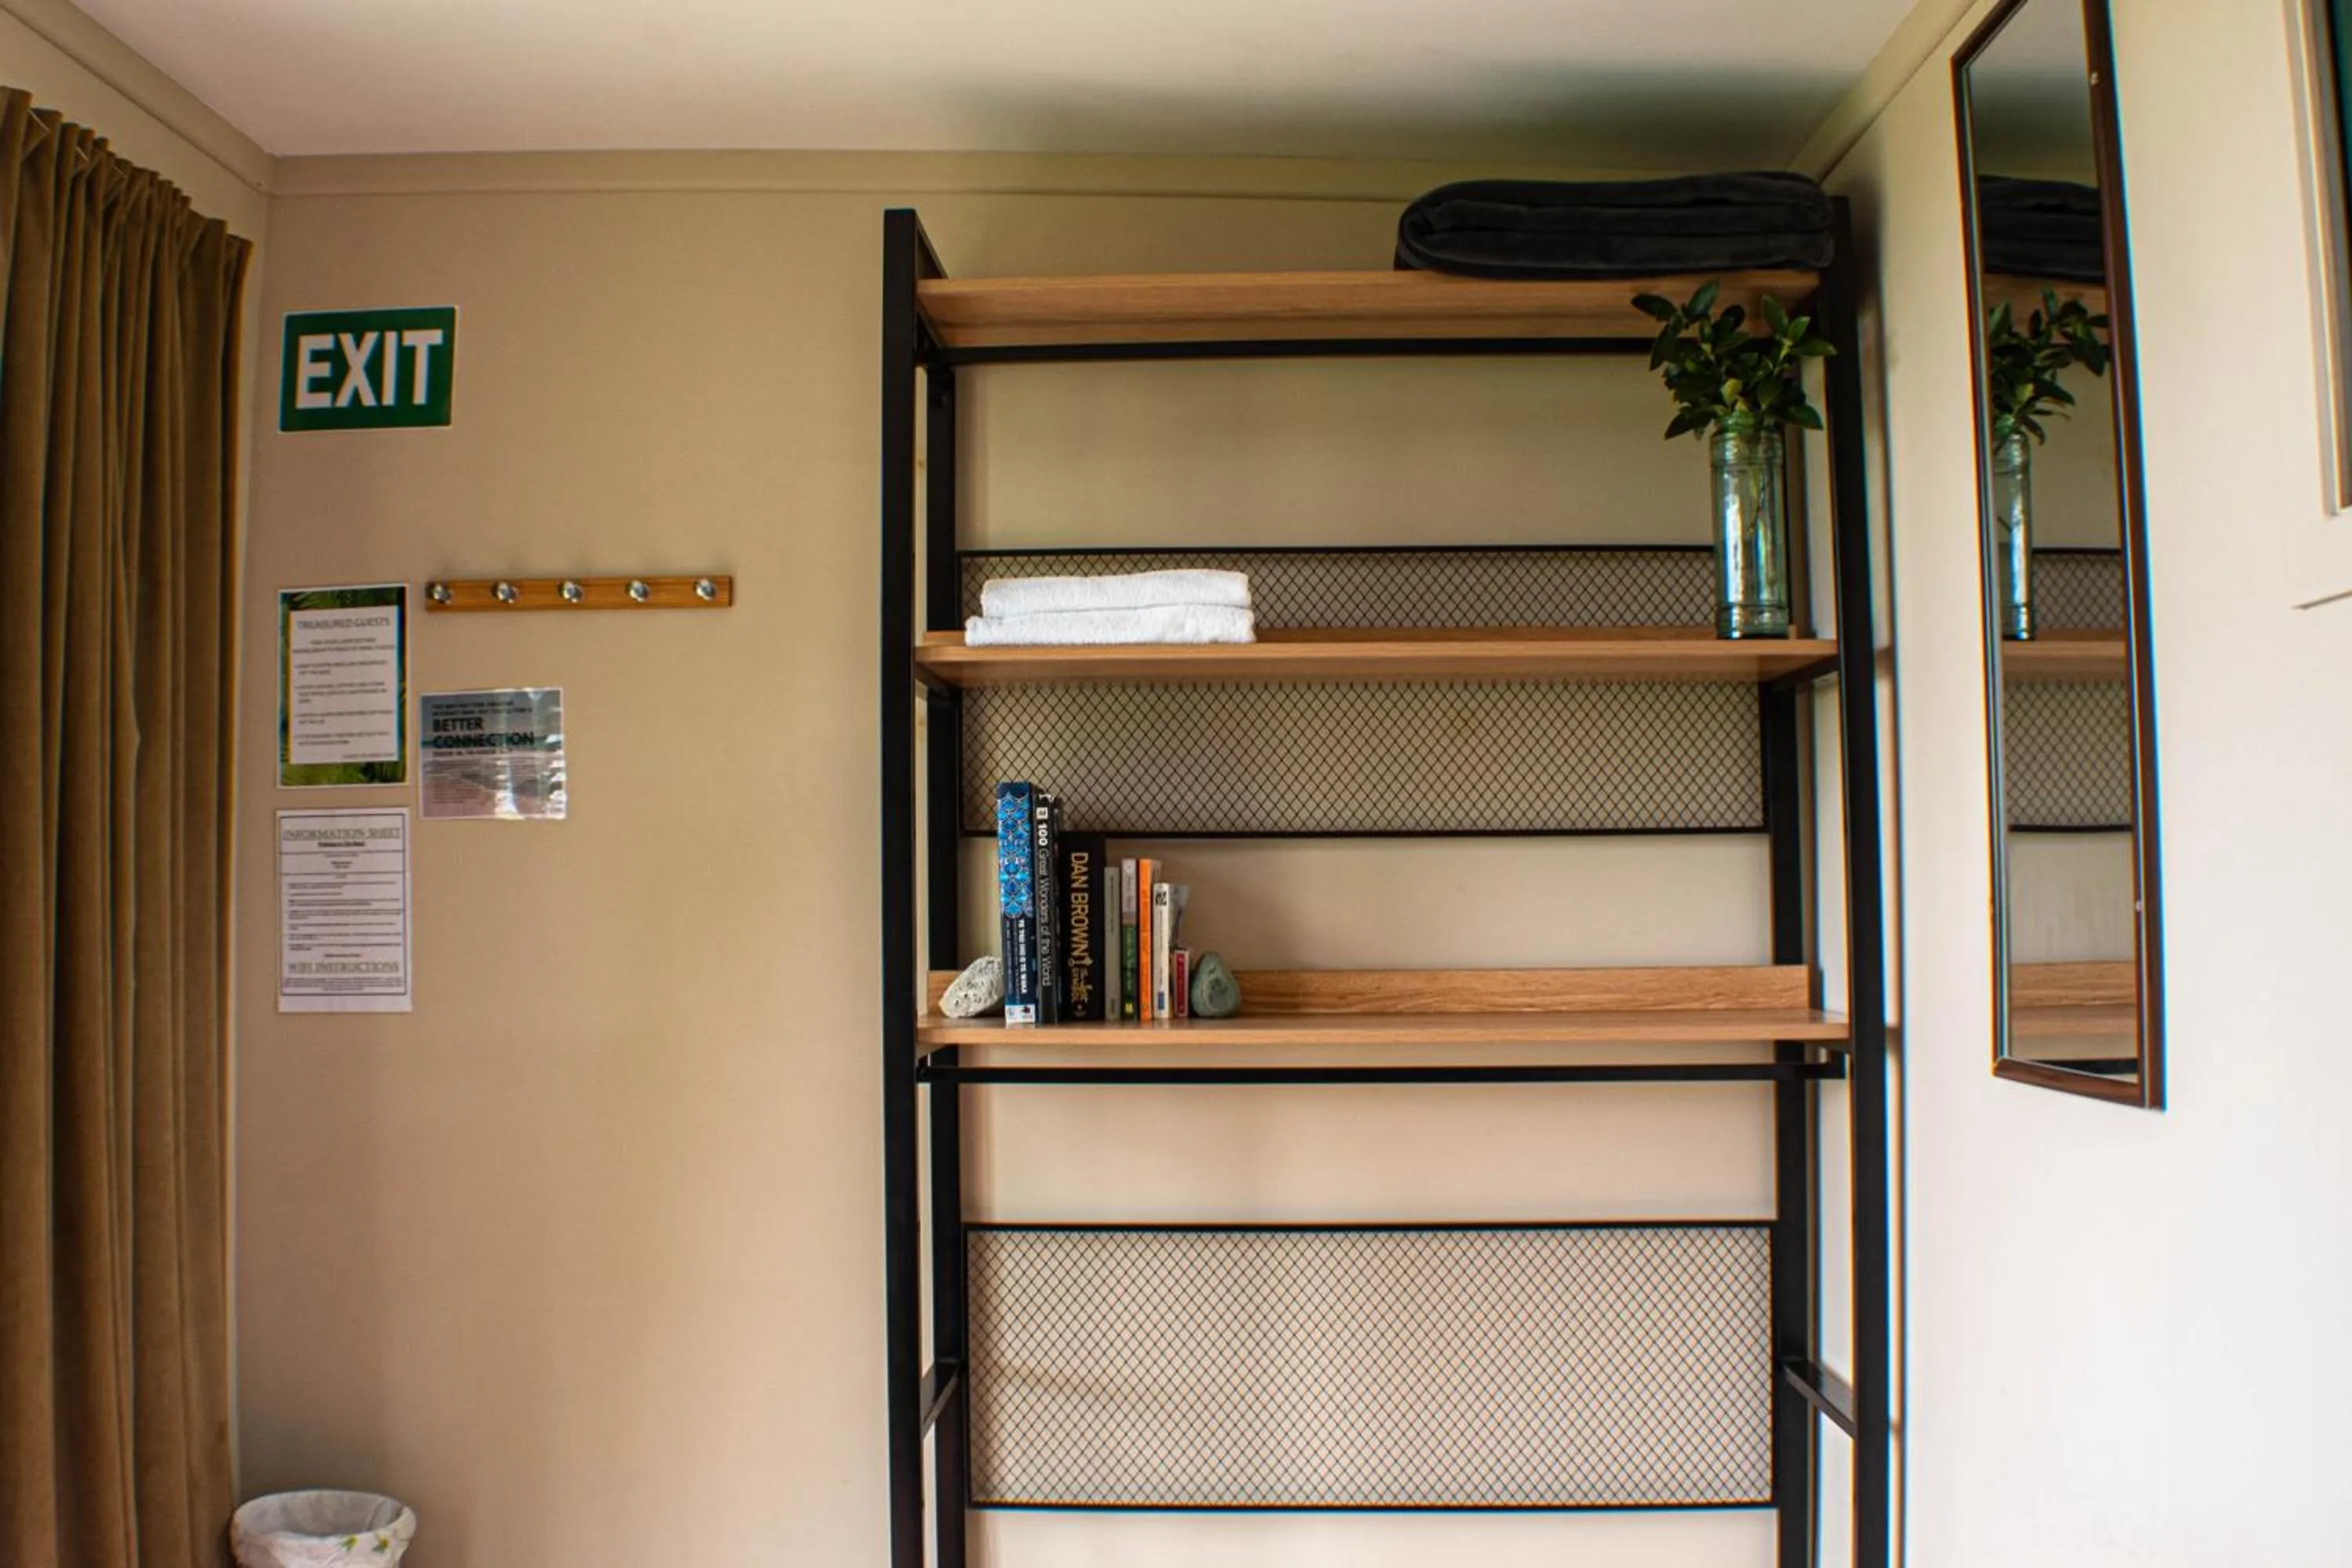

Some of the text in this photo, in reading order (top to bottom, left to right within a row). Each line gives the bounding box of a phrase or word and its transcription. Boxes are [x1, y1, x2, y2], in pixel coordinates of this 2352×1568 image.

[296, 328, 444, 409] EXIT
[354, 616, 390, 628] GUESTS
[432, 717, 484, 732] BETTER
[432, 731, 535, 750] CONNECTION
[282, 826, 401, 841] INFORMATION SHEET
[1037, 823, 1048, 846] 100
[1070, 852, 1089, 888] DAN
[1039, 877, 1051, 924] Wonders
[1070, 892, 1089, 958] BROWN
[1041, 955, 1051, 987] World
